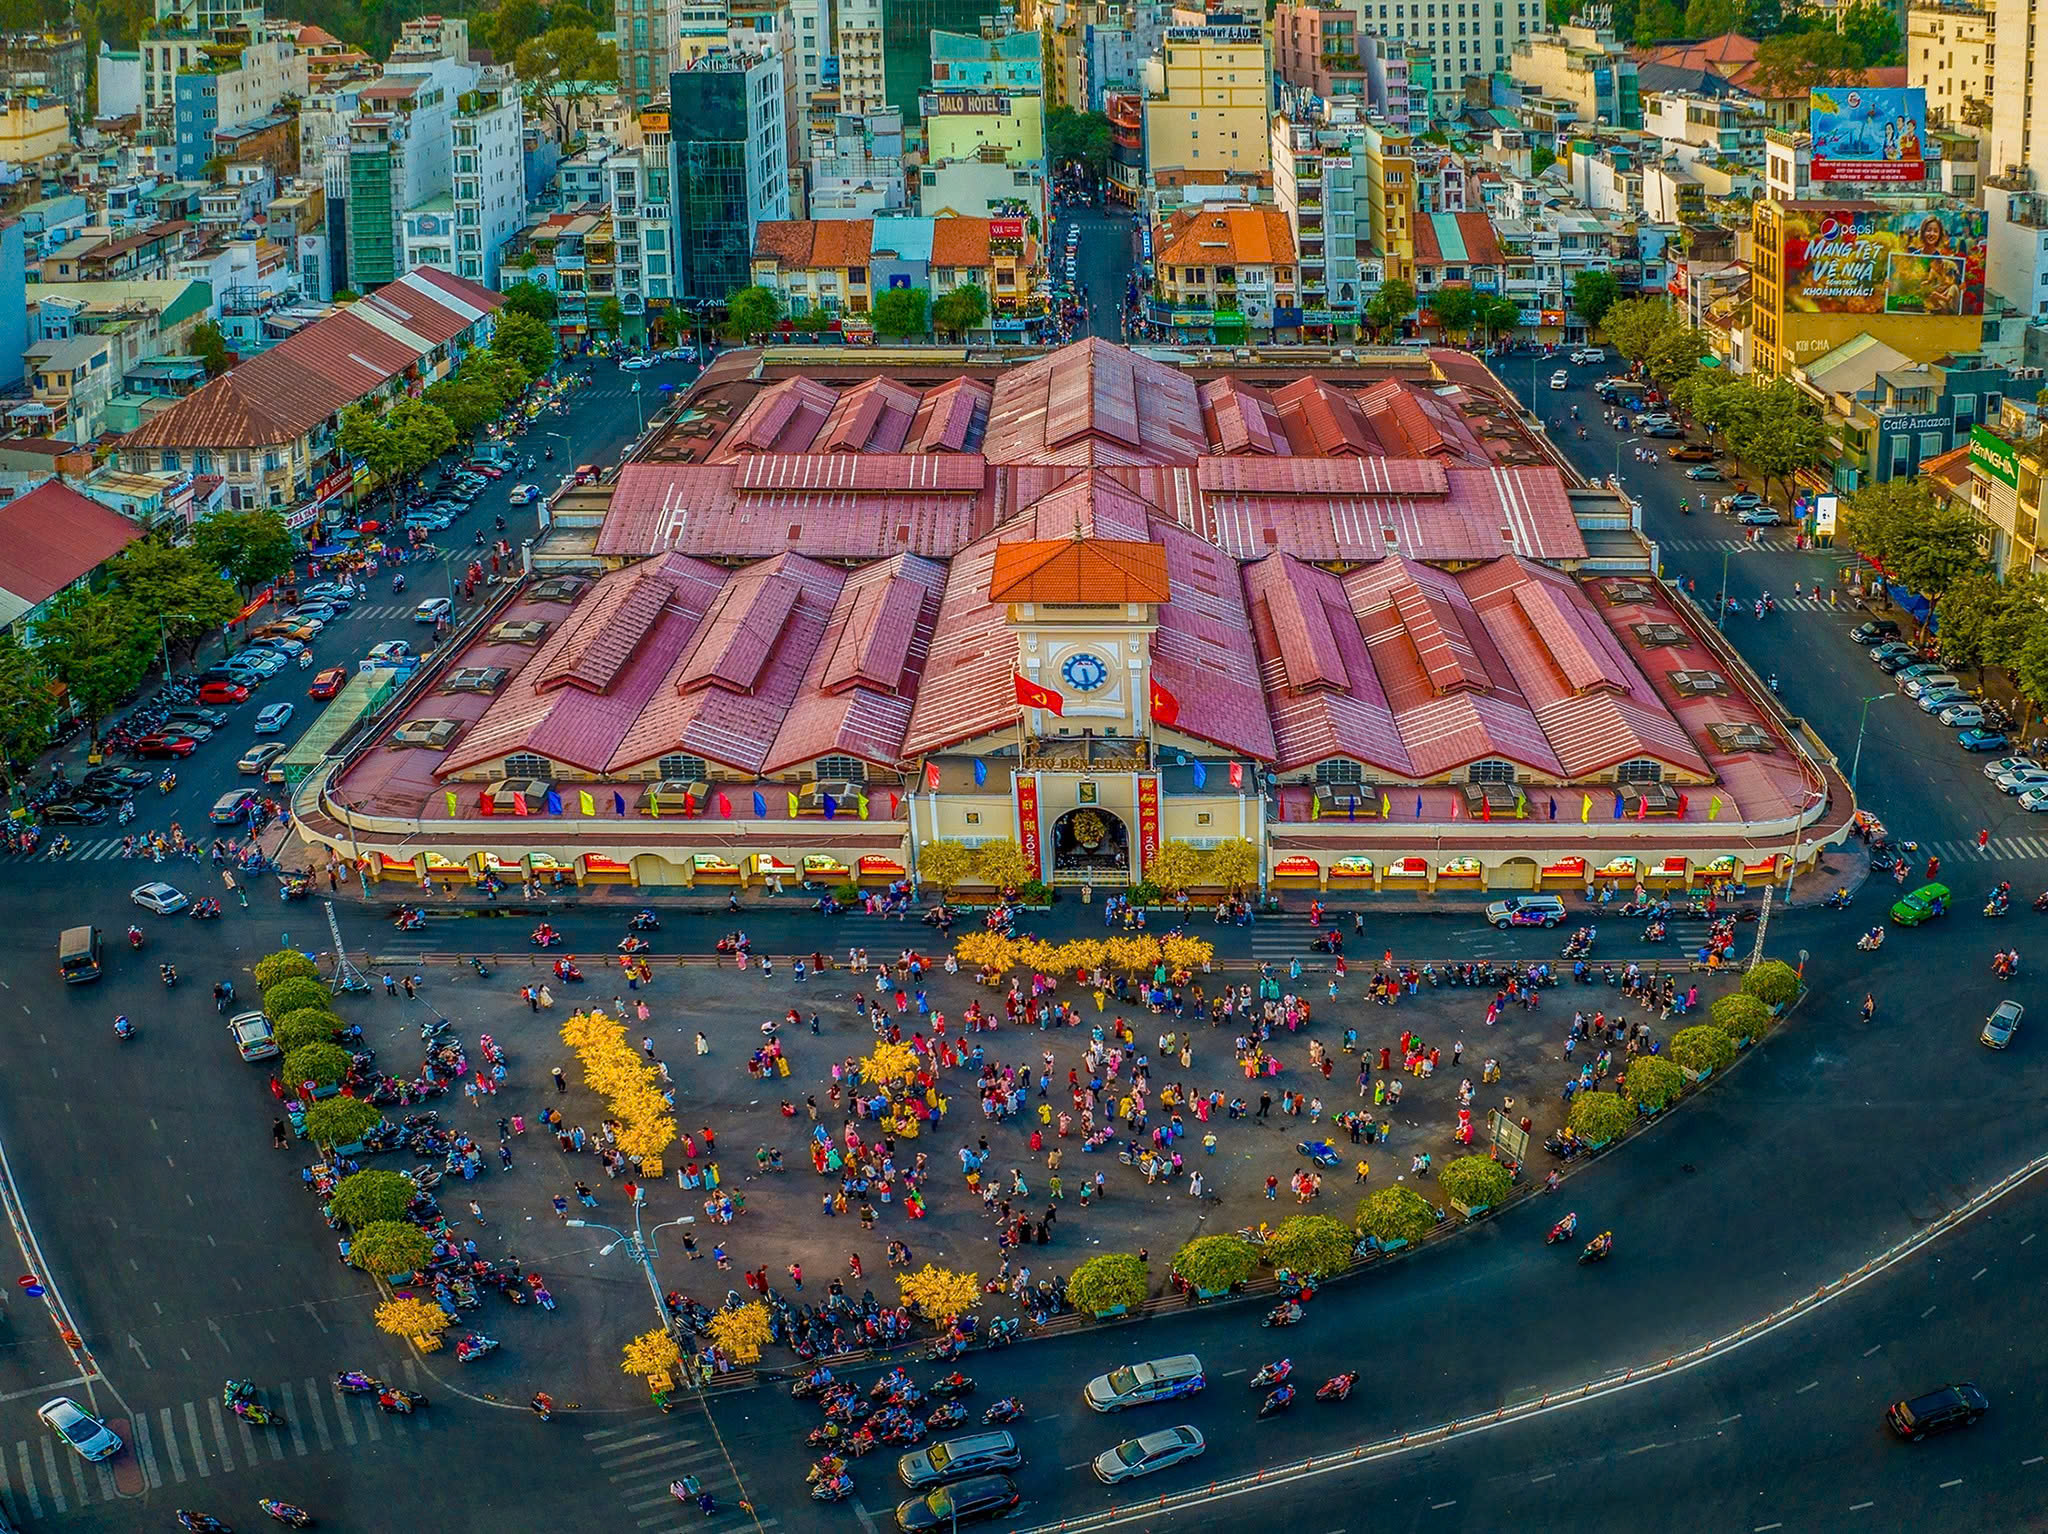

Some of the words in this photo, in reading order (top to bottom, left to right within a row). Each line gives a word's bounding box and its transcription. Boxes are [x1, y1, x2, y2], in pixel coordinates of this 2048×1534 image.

[939, 96, 964, 112] HALO
[968, 97, 998, 112] HOTEL
[1840, 222, 1875, 235] pepsi
[1803, 239, 1853, 261] MANG
[1854, 239, 1884, 261] TẾT
[1813, 257, 1839, 282] VỀ
[1842, 259, 1877, 281] NHÀ
[1882, 417, 1908, 431] Café
[1908, 417, 1951, 429] Amazon
[1059, 754, 1089, 770] BẾN
